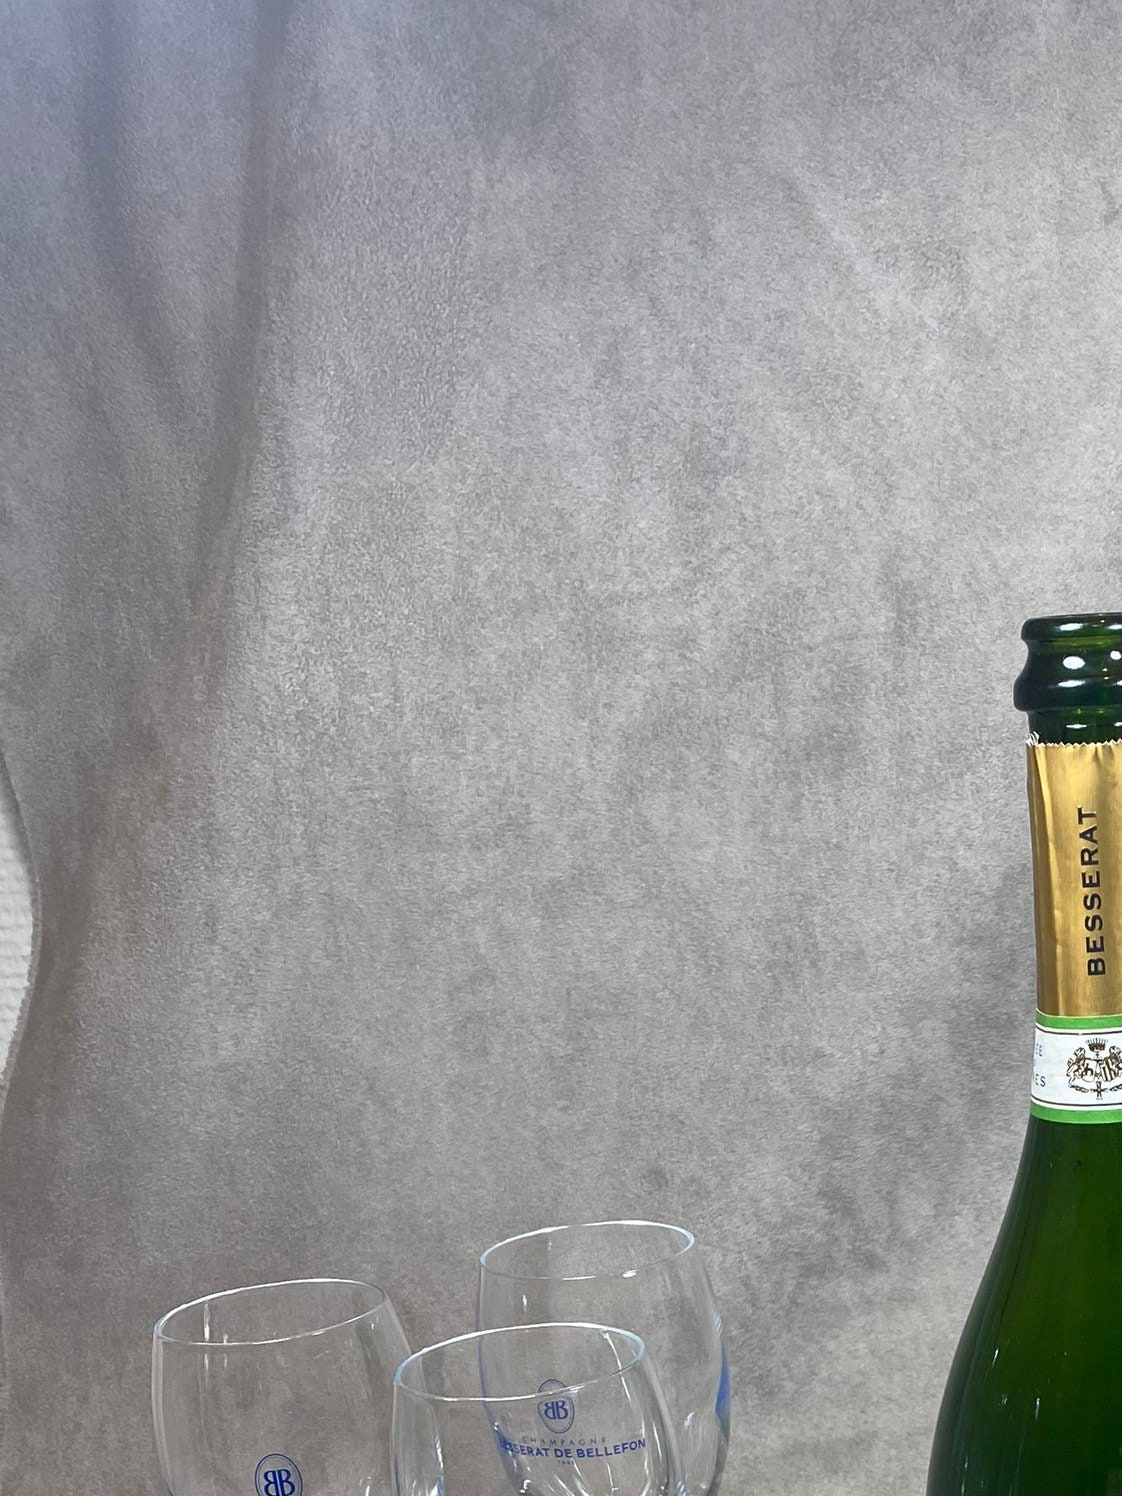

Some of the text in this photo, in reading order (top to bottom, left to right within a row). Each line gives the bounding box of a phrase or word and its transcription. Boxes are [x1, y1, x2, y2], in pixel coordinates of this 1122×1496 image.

[1077, 806, 1106, 976] BESSERAT
[554, 1448, 573, 1458] DE
[576, 1438, 646, 1458] BELLEFON
